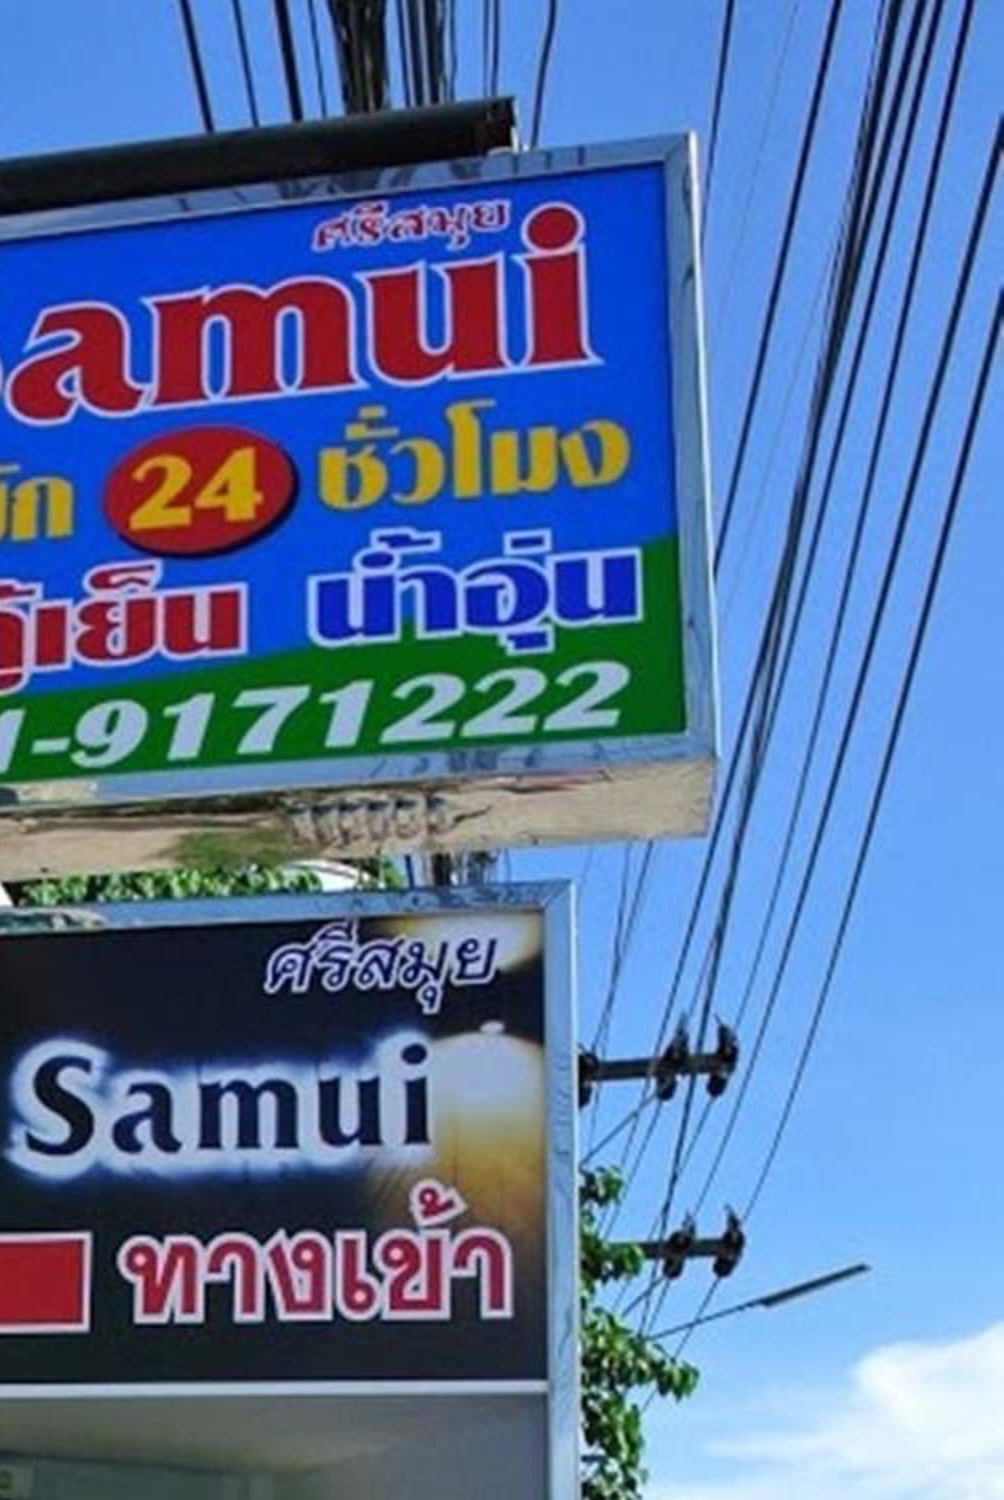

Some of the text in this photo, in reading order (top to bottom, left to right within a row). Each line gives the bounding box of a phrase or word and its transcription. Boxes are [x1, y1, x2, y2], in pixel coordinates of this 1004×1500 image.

[312, 200, 511, 251] ศรีสมุย
[128, 448, 264, 532] 24
[319, 399, 633, 511] ชั่วโมง
[308, 528, 644, 654] น้ำอุ่น
[264, 922, 498, 1014] ศรีสมุย
[23, 1041, 433, 1155] Samui
[116, 1180, 515, 1323] ทางเข้า
